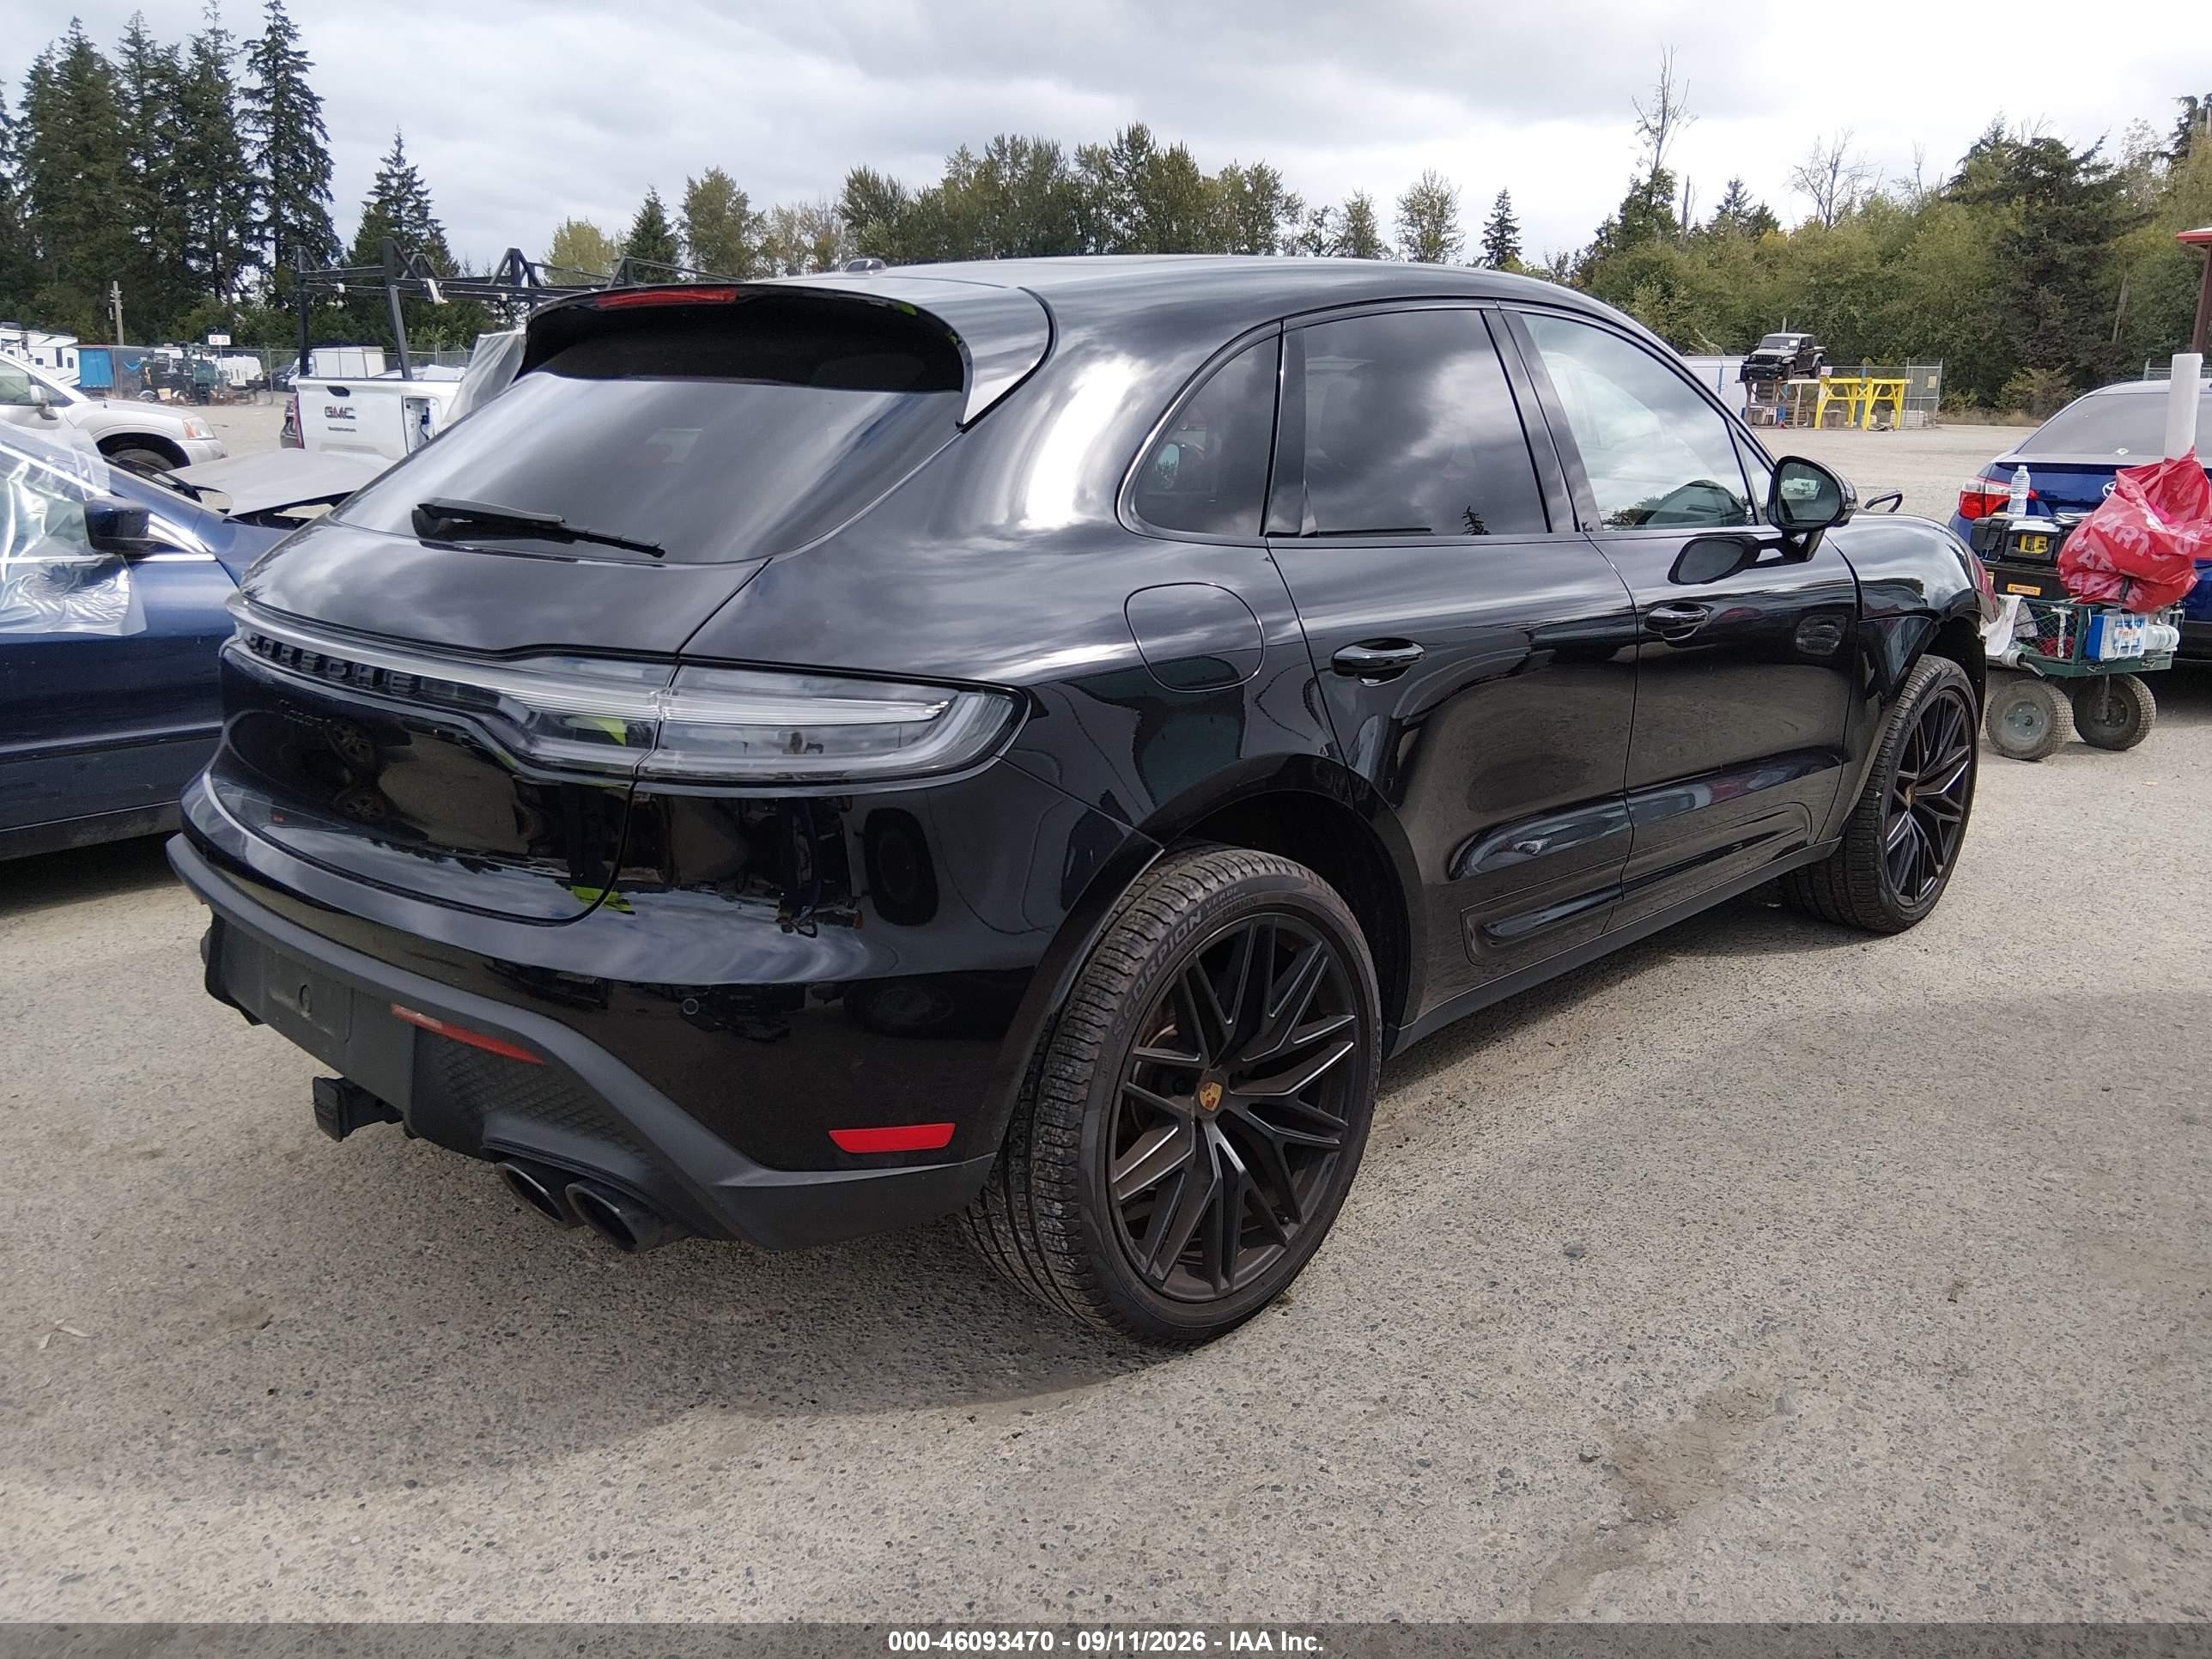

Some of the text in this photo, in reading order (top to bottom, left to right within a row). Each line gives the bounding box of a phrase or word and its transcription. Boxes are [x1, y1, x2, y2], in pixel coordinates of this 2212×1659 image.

[325, 405, 357, 420] GMC
[247, 631, 417, 697] PORSCHE
[1113, 908, 1202, 1040] SCORPION
